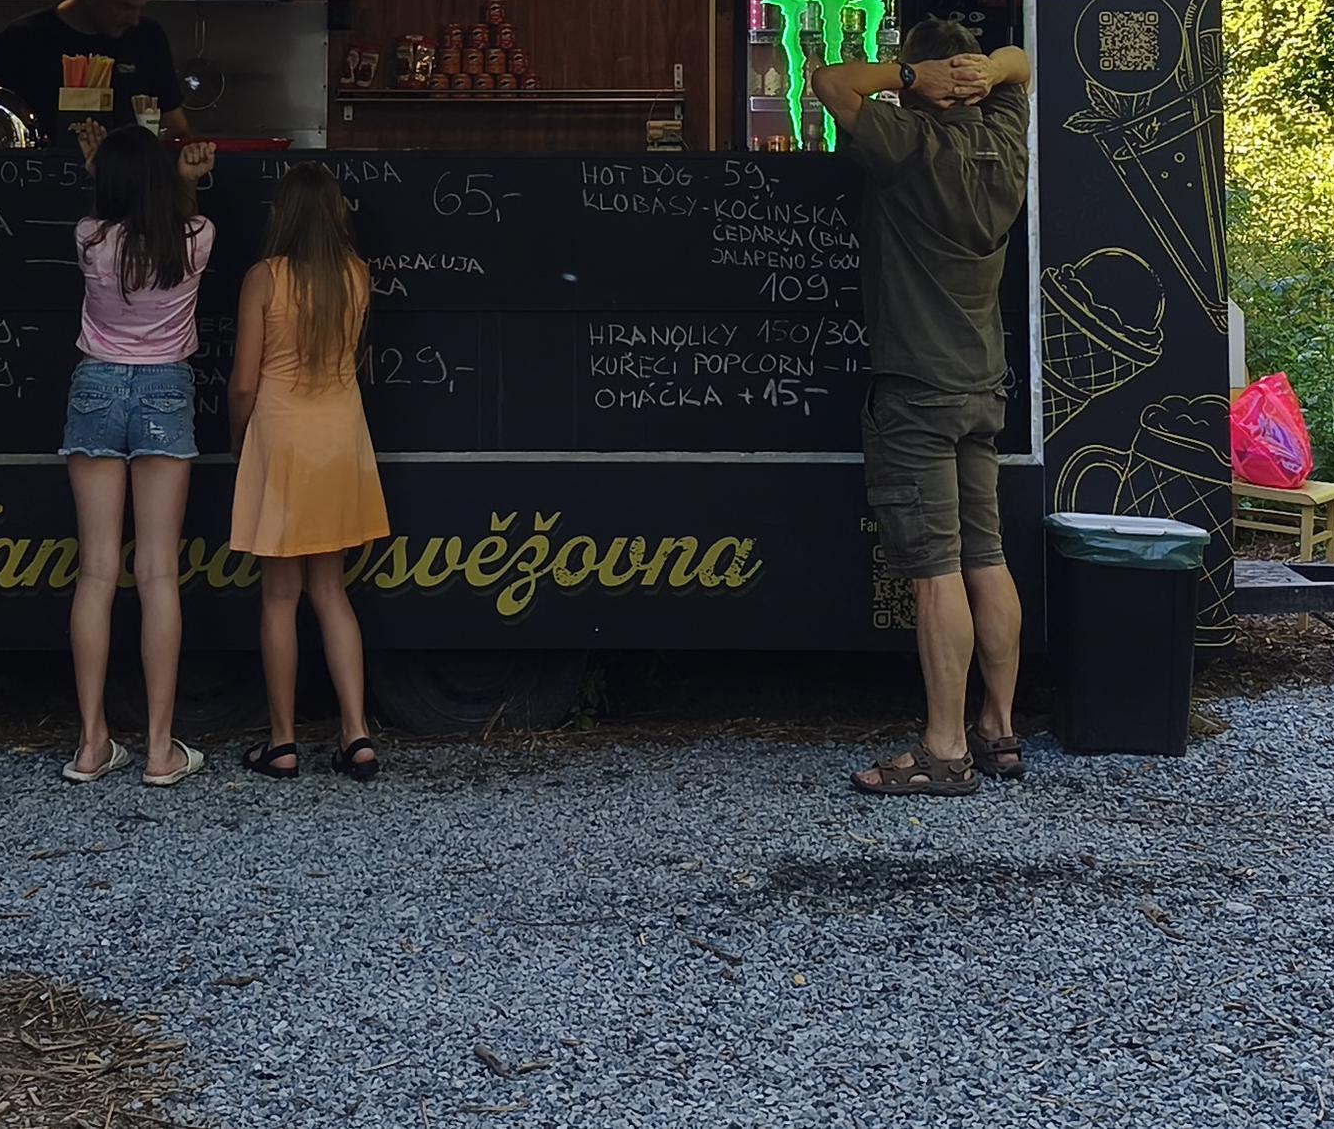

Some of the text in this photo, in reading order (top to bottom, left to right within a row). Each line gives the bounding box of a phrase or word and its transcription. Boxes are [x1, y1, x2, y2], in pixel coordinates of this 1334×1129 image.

[260, 158, 403, 183] LINÁDA
[582, 161, 633, 186] HOT
[641, 163, 693, 186] DOG
[811, 253, 824, 269] S
[588, 322, 738, 348] HRANOLKY
[694, 352, 815, 376] POPCORN
[594, 381, 723, 409] OMÁČKA
[345, 511, 763, 617] svěžovna
